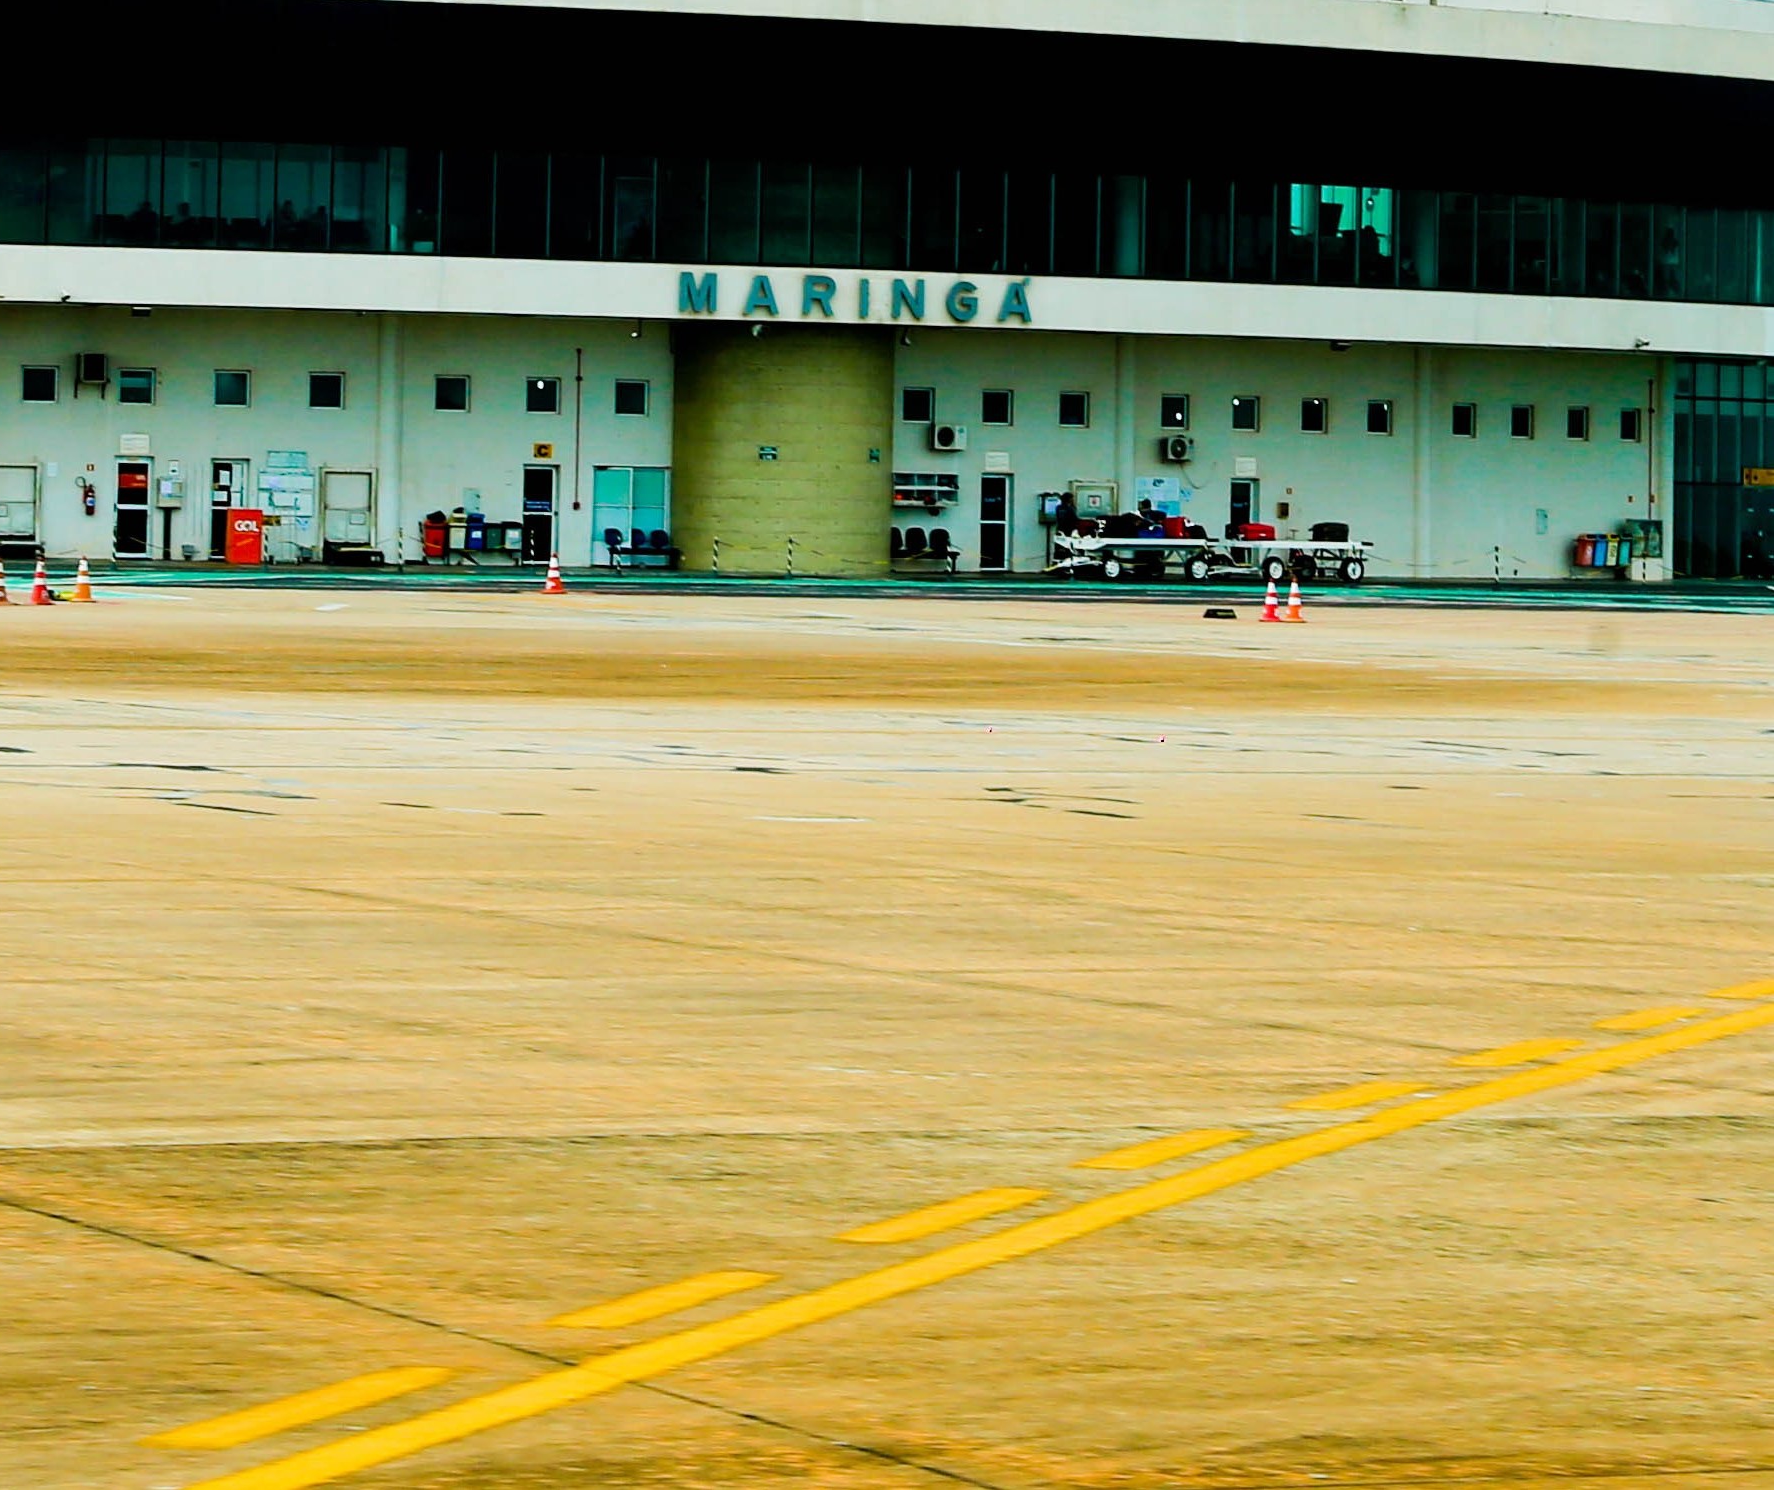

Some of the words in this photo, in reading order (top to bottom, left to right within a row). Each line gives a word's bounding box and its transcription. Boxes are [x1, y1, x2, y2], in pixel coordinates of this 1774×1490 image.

[679, 272, 1032, 323] MARINGÁ
[537, 445, 549, 457] C
[234, 520, 260, 532] GOL
